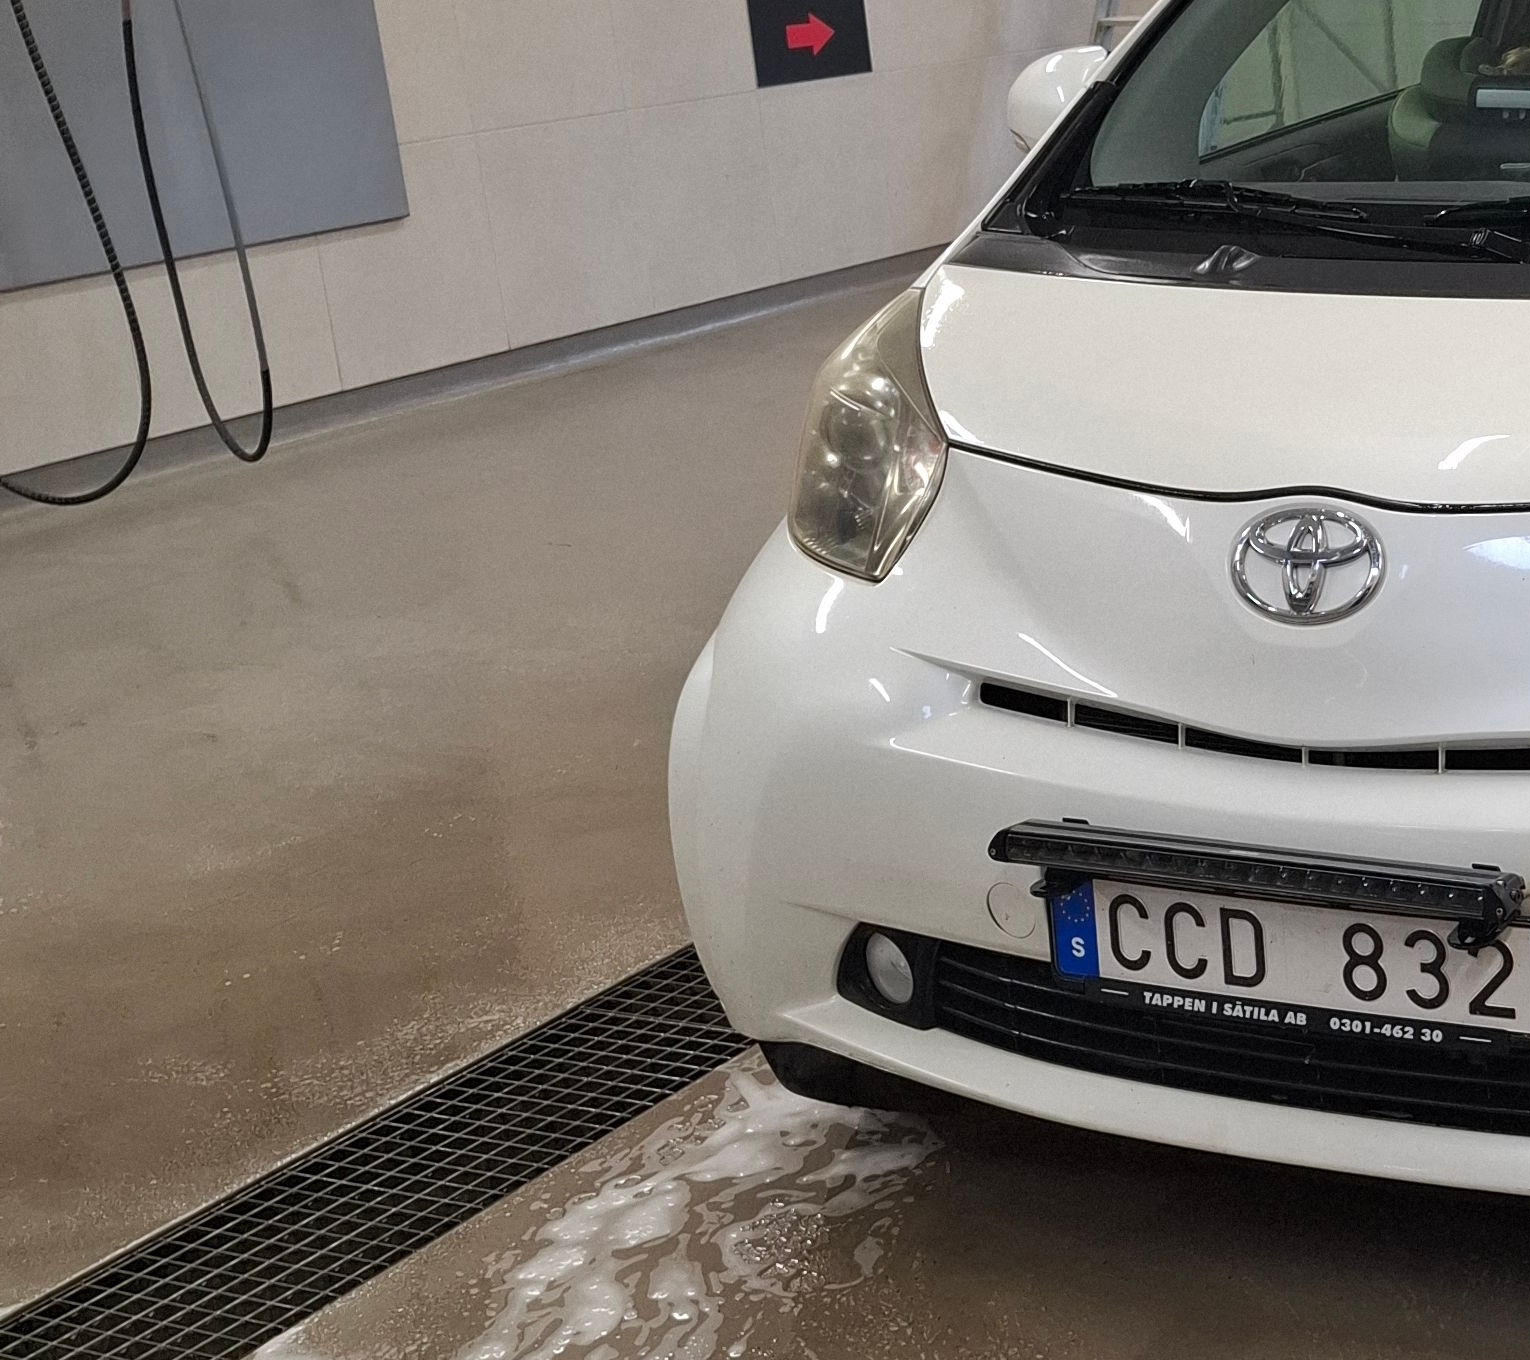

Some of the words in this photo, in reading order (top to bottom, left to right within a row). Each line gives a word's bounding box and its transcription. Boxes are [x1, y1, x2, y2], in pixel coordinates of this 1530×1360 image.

[1071, 937, 1085, 958] S
[1108, 893, 1265, 988] CCD
[1342, 923, 1517, 1019] 832
[1143, 992, 1206, 1012] TAPPEN
[1211, 1001, 1218, 1014] I
[1223, 1001, 1280, 1022] SÄTILA
[1284, 1011, 1307, 1026] AB
[1329, 1017, 1414, 1039] 0301-462
[1420, 1028, 1443, 1043] 30
